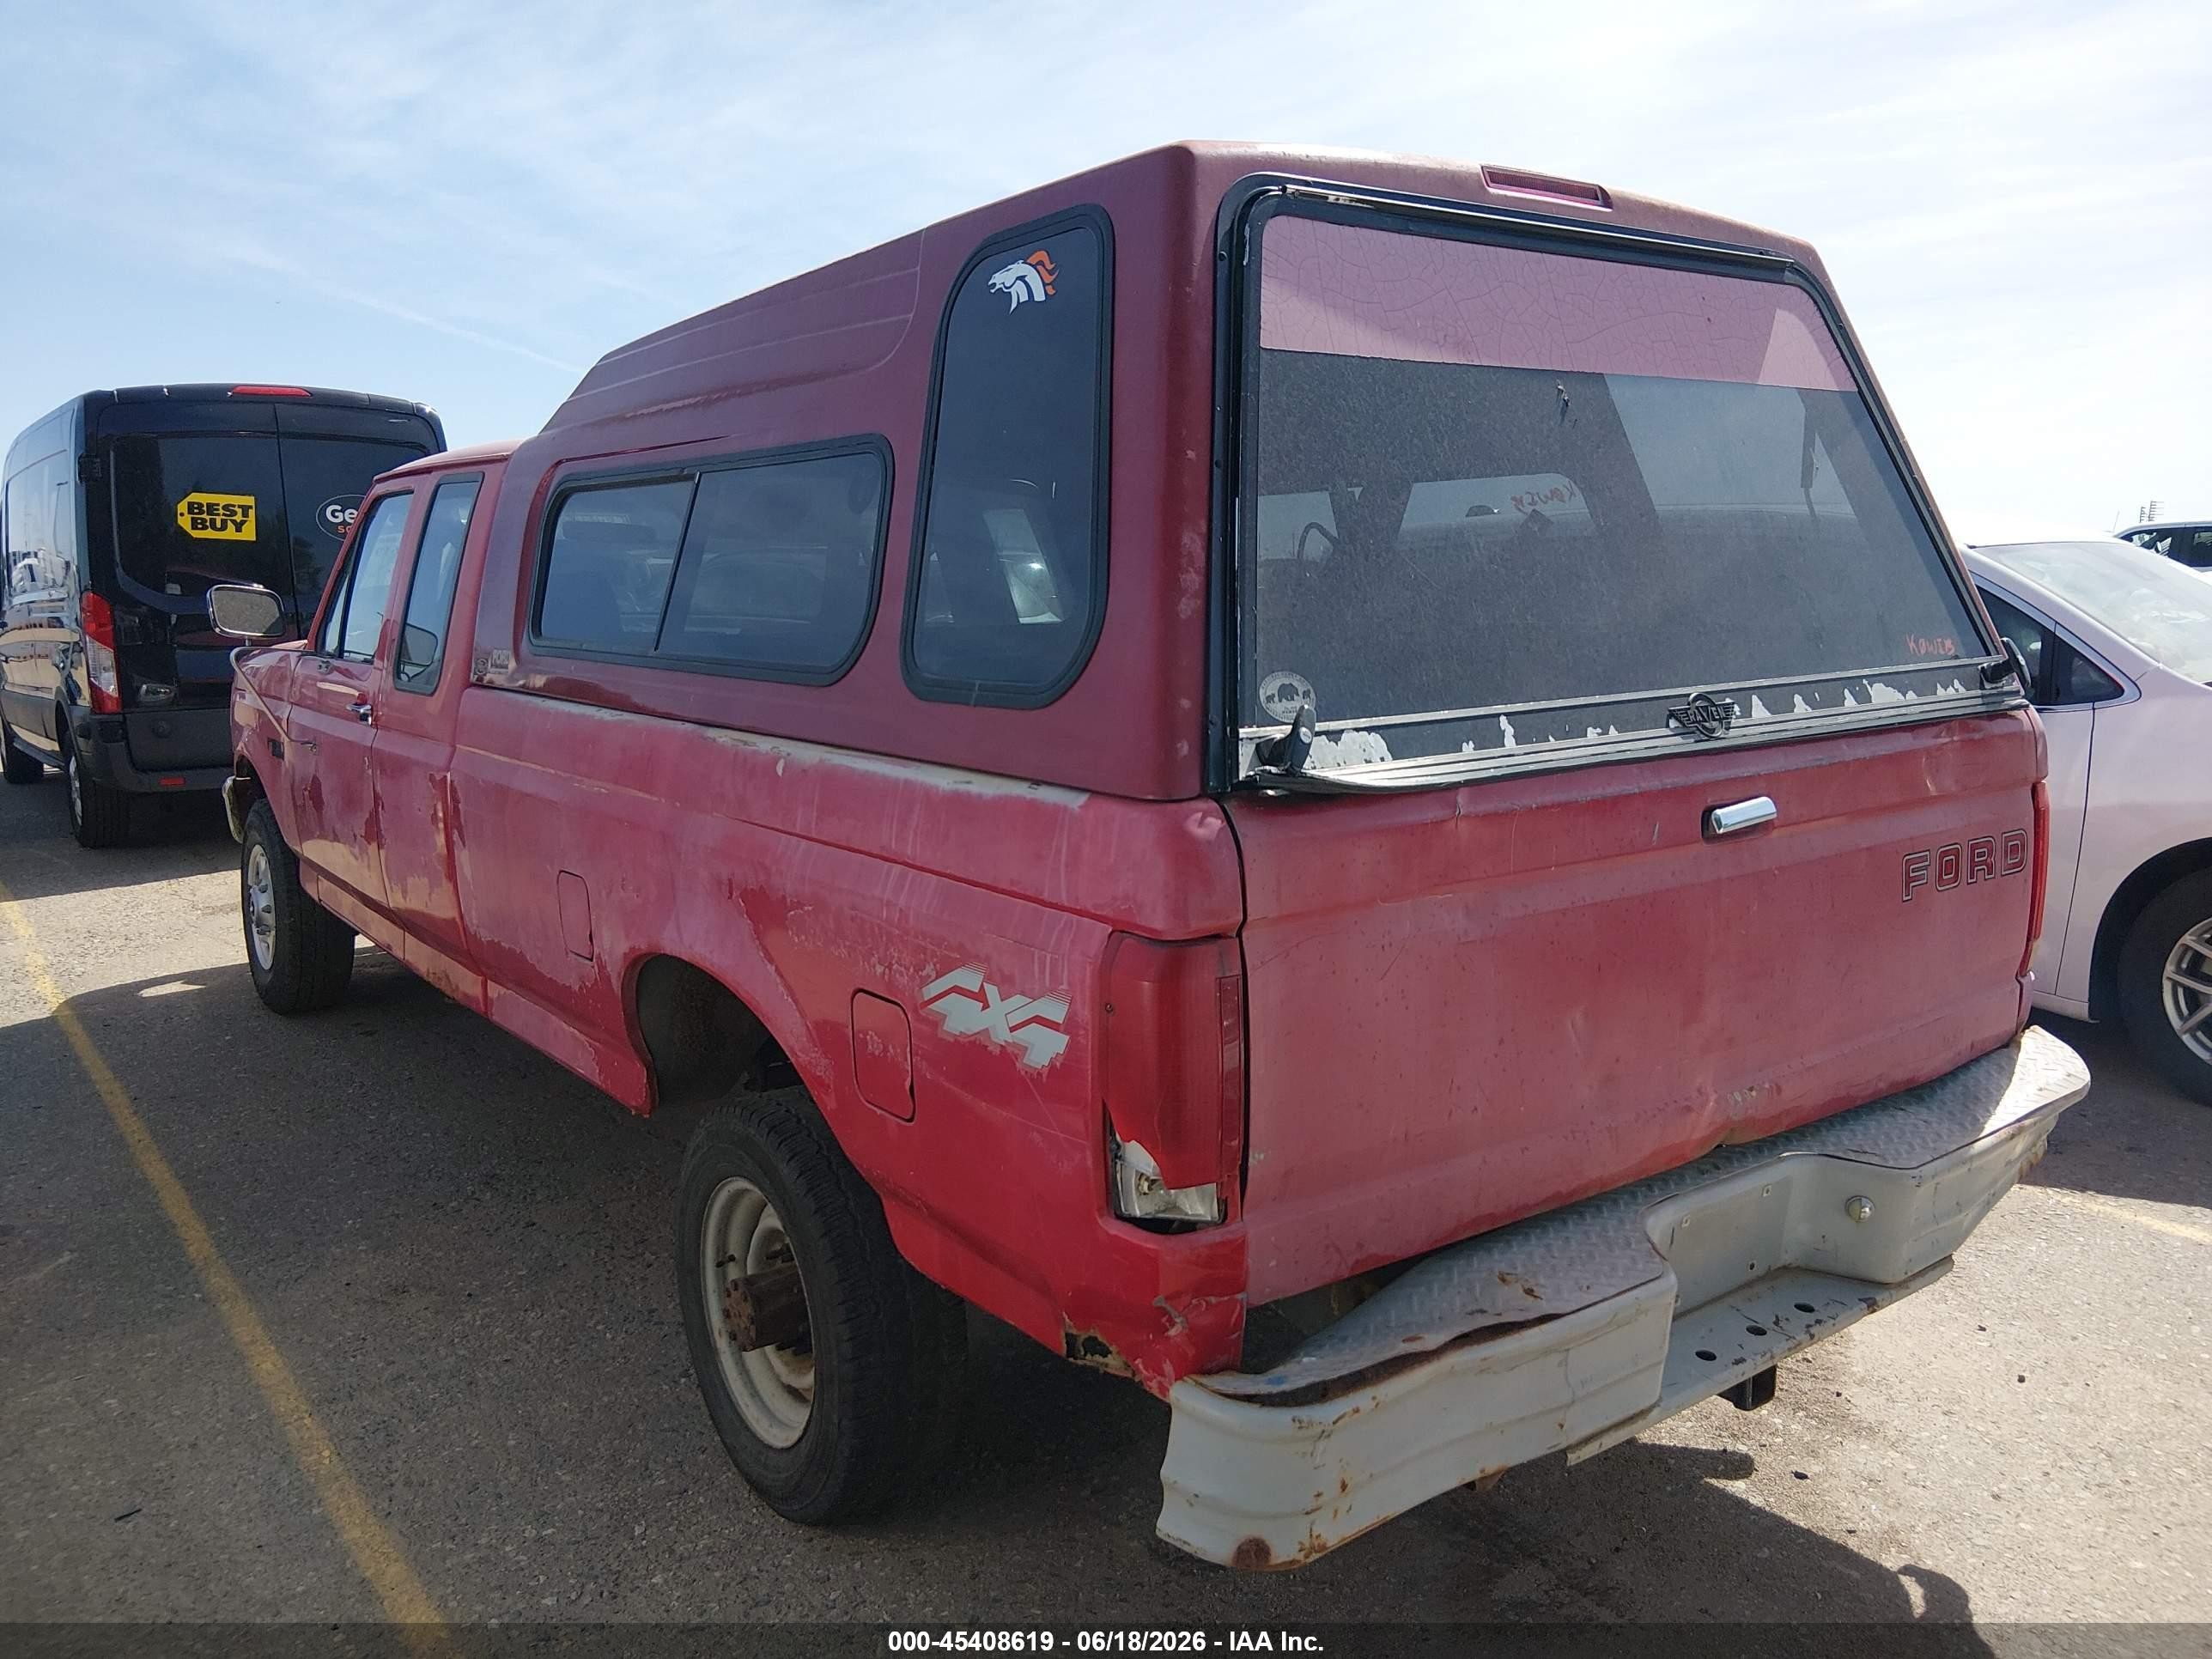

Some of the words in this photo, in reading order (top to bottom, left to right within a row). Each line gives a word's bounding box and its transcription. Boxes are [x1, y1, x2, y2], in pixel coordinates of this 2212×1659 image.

[187, 501, 252, 519] BEST
[326, 505, 359, 523] Ge
[191, 519, 246, 533] BUY
[1687, 704, 1726, 727] RAVEN
[1901, 828, 2028, 902] FORD
